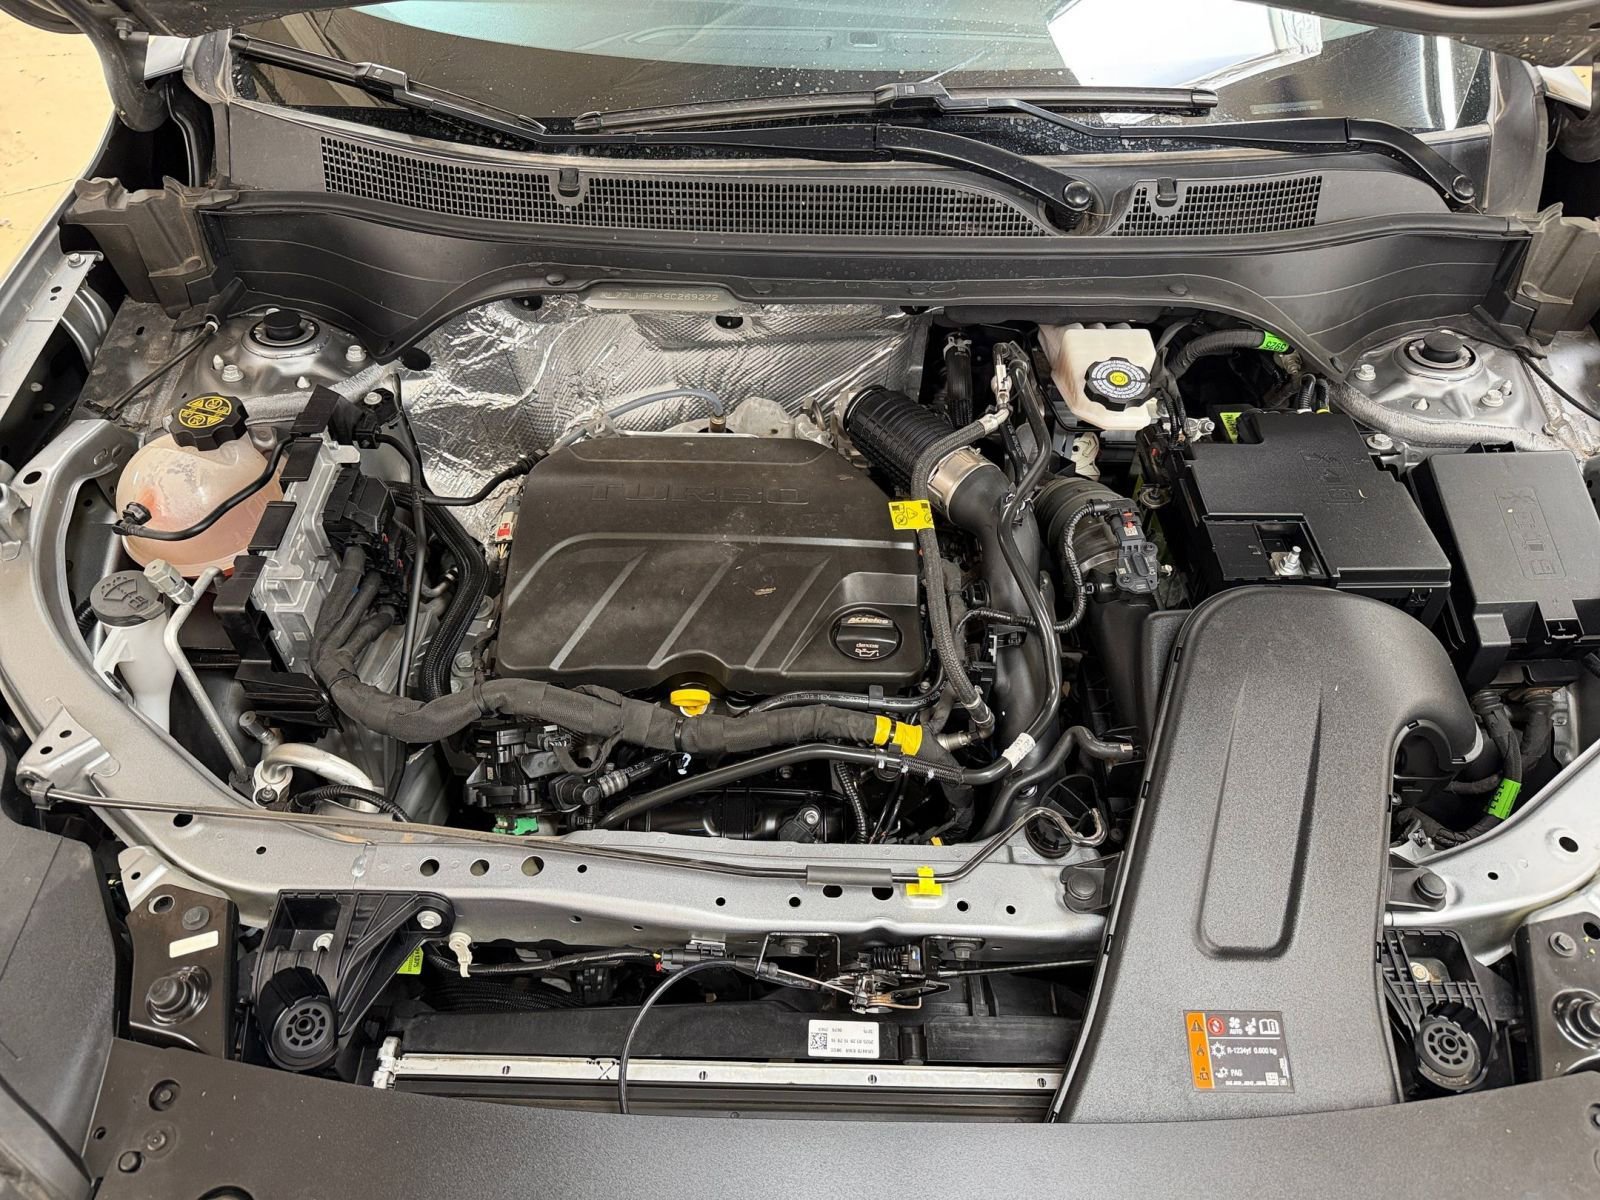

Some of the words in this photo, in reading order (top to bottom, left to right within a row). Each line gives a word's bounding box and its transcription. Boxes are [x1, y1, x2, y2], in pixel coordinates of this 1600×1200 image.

[579, 484, 809, 505] TURBO
[847, 616, 889, 624] ACDelco
[1226, 1046, 1252, 1055] R-1234yf
[1269, 1047, 1278, 1056] kg
[1230, 1068, 1243, 1077] PAG
